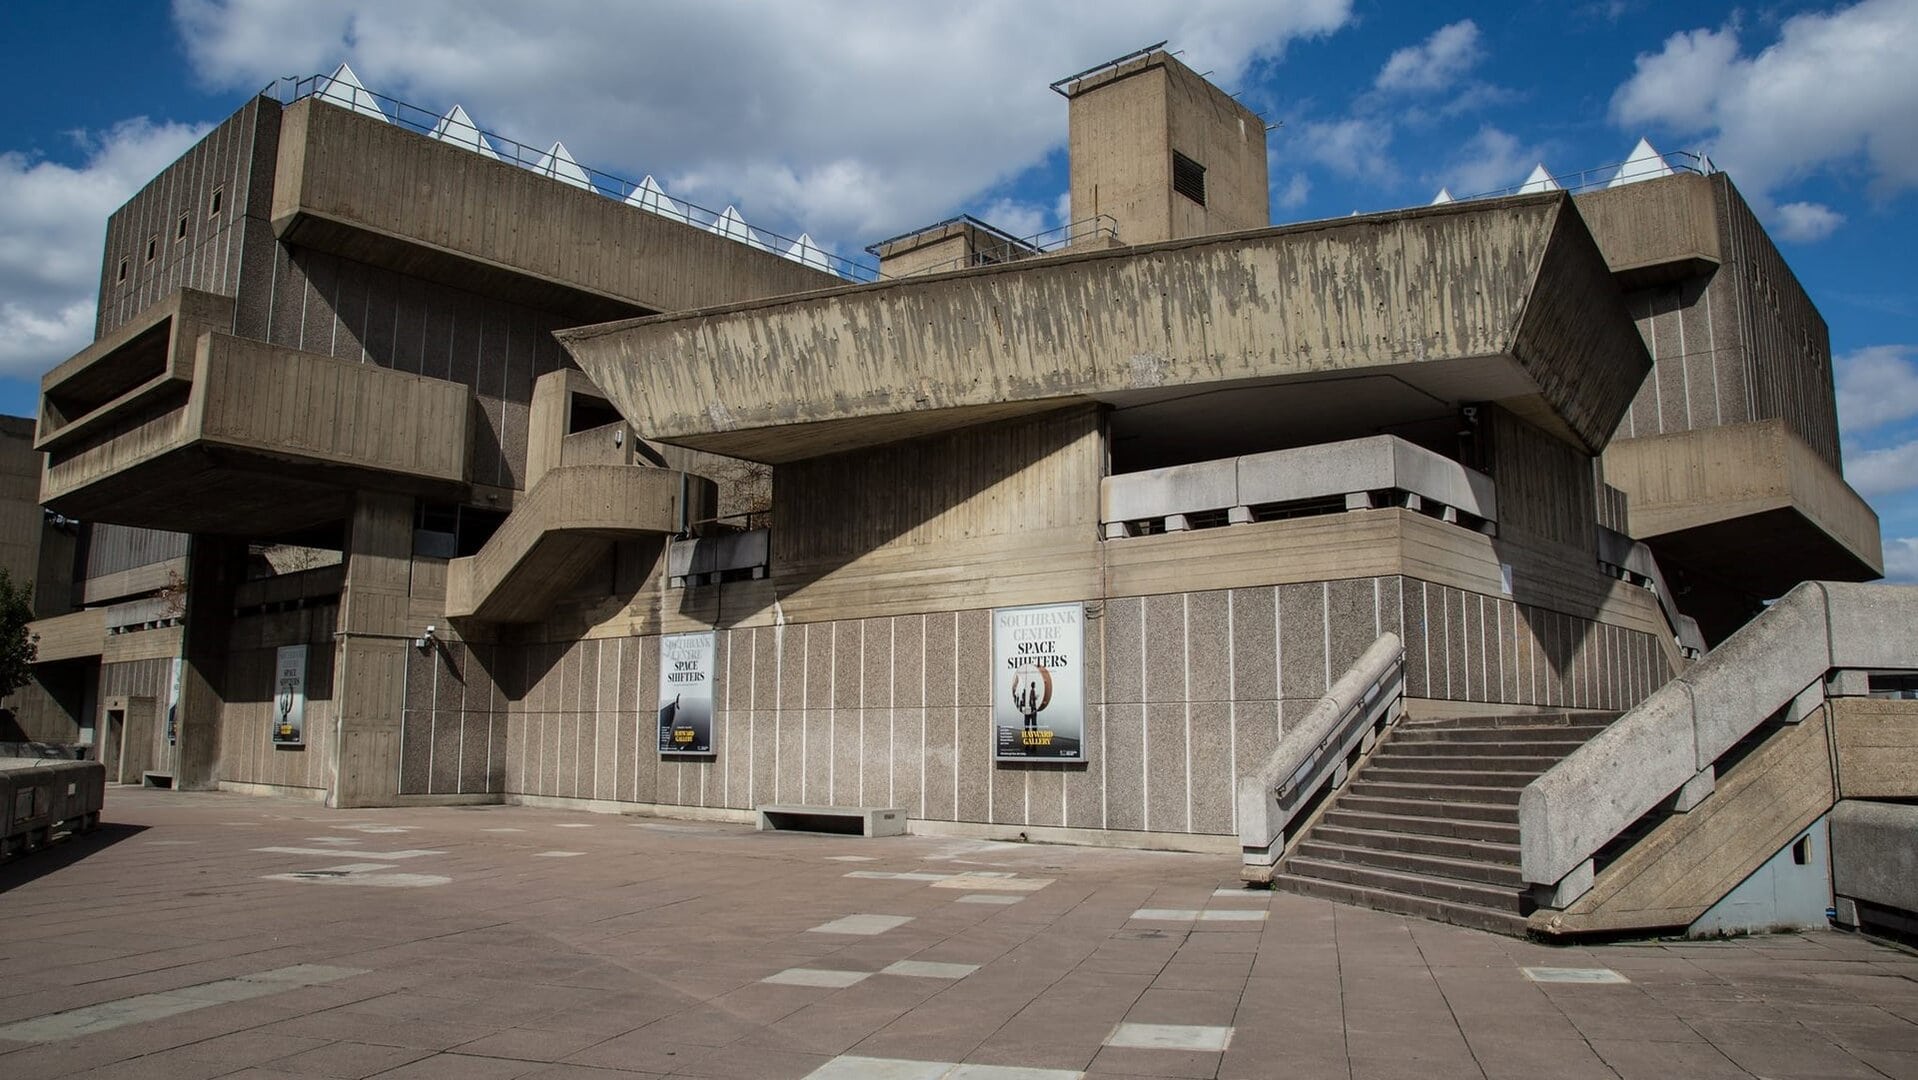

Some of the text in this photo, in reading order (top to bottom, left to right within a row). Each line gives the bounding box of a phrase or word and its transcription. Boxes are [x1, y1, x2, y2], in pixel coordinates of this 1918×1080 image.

[1000, 611, 1076, 627] SOUTHBANK
[1012, 626, 1062, 641] CENTRE
[1018, 641, 1056, 655] SPACE
[674, 660, 698, 671] SPACE
[667, 671, 705, 683] SHIFTERS
[1021, 730, 1054, 738] HAYWARD
[1023, 737, 1052, 745] GALLERY
